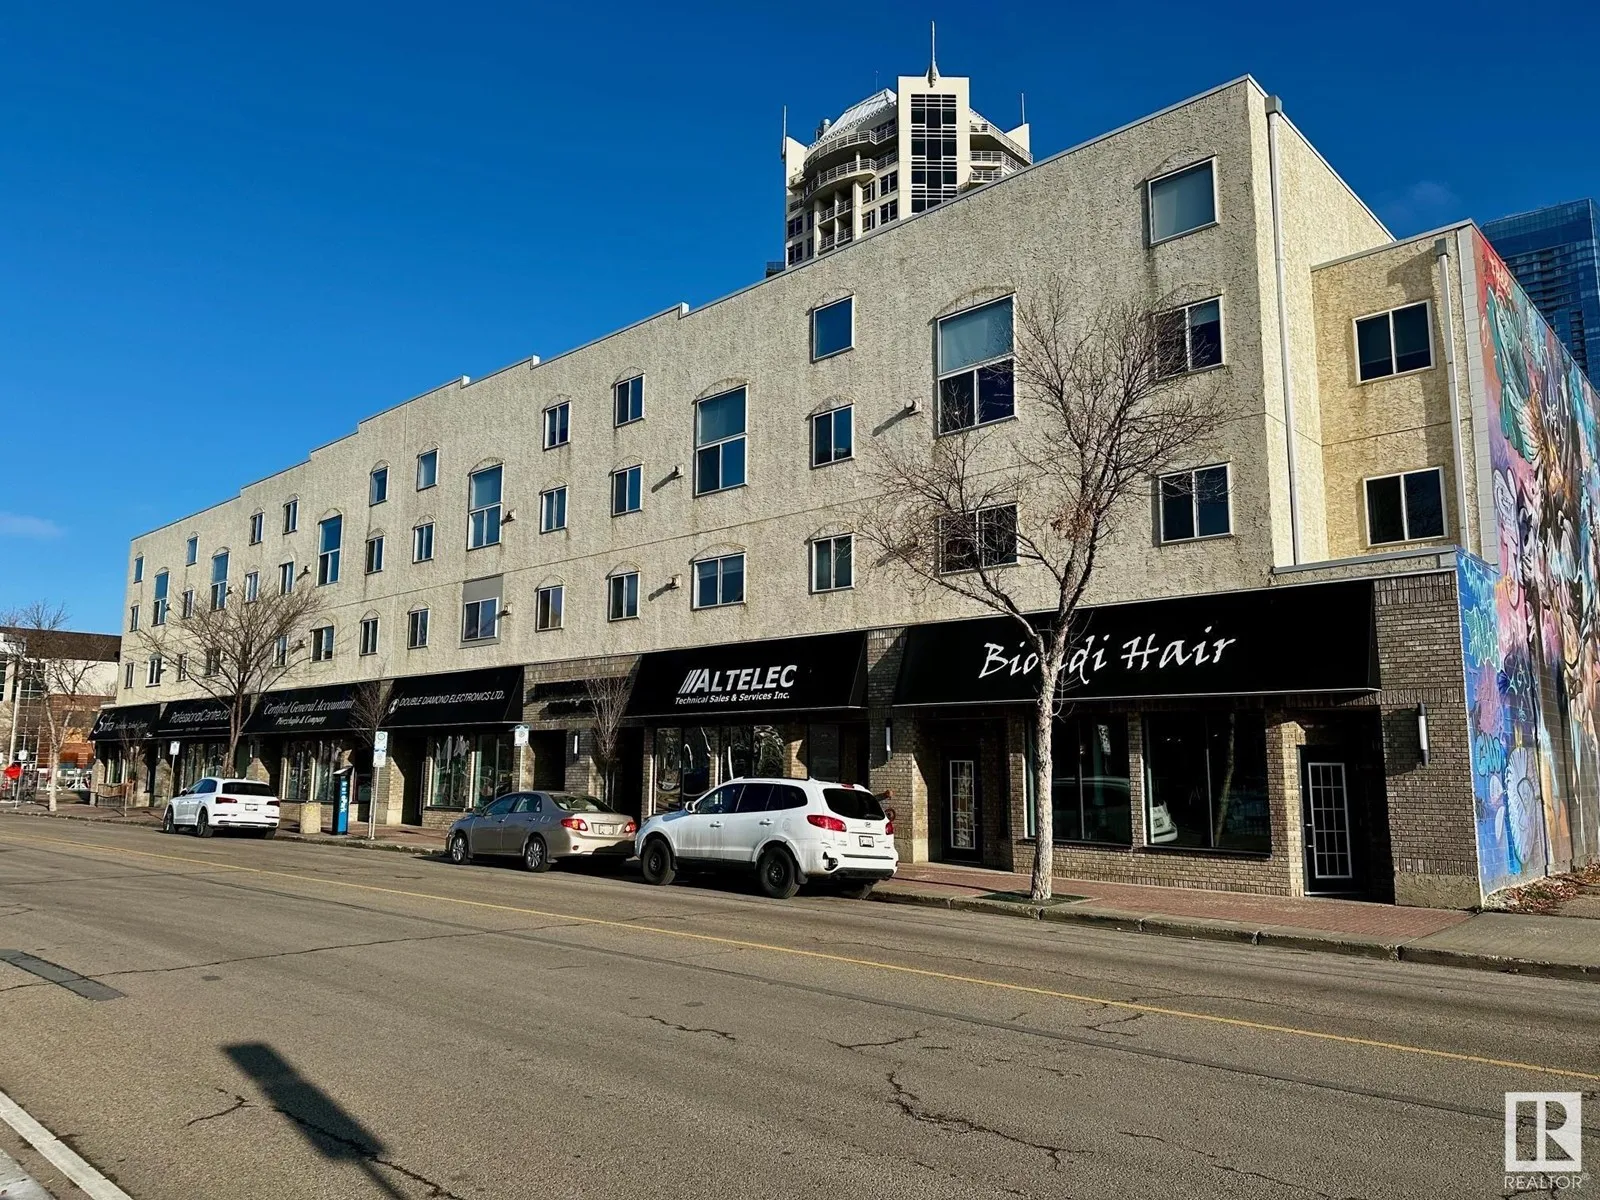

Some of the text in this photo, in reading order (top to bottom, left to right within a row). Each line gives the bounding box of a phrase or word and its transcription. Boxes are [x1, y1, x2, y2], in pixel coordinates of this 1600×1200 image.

[1120, 626, 1237, 671] Hair
[690, 664, 798, 694] ALTELEC
[399, 690, 505, 707] DOUBLE DIAMOND ELECTRONICS LTD.
[674, 691, 790, 705] Technical Sales & Services Inc.
[169, 708, 232, 724] ProfessionalCentre.co
[263, 701, 293, 717] Certified
[289, 699, 319, 714] General
[304, 714, 327, 726] Company
